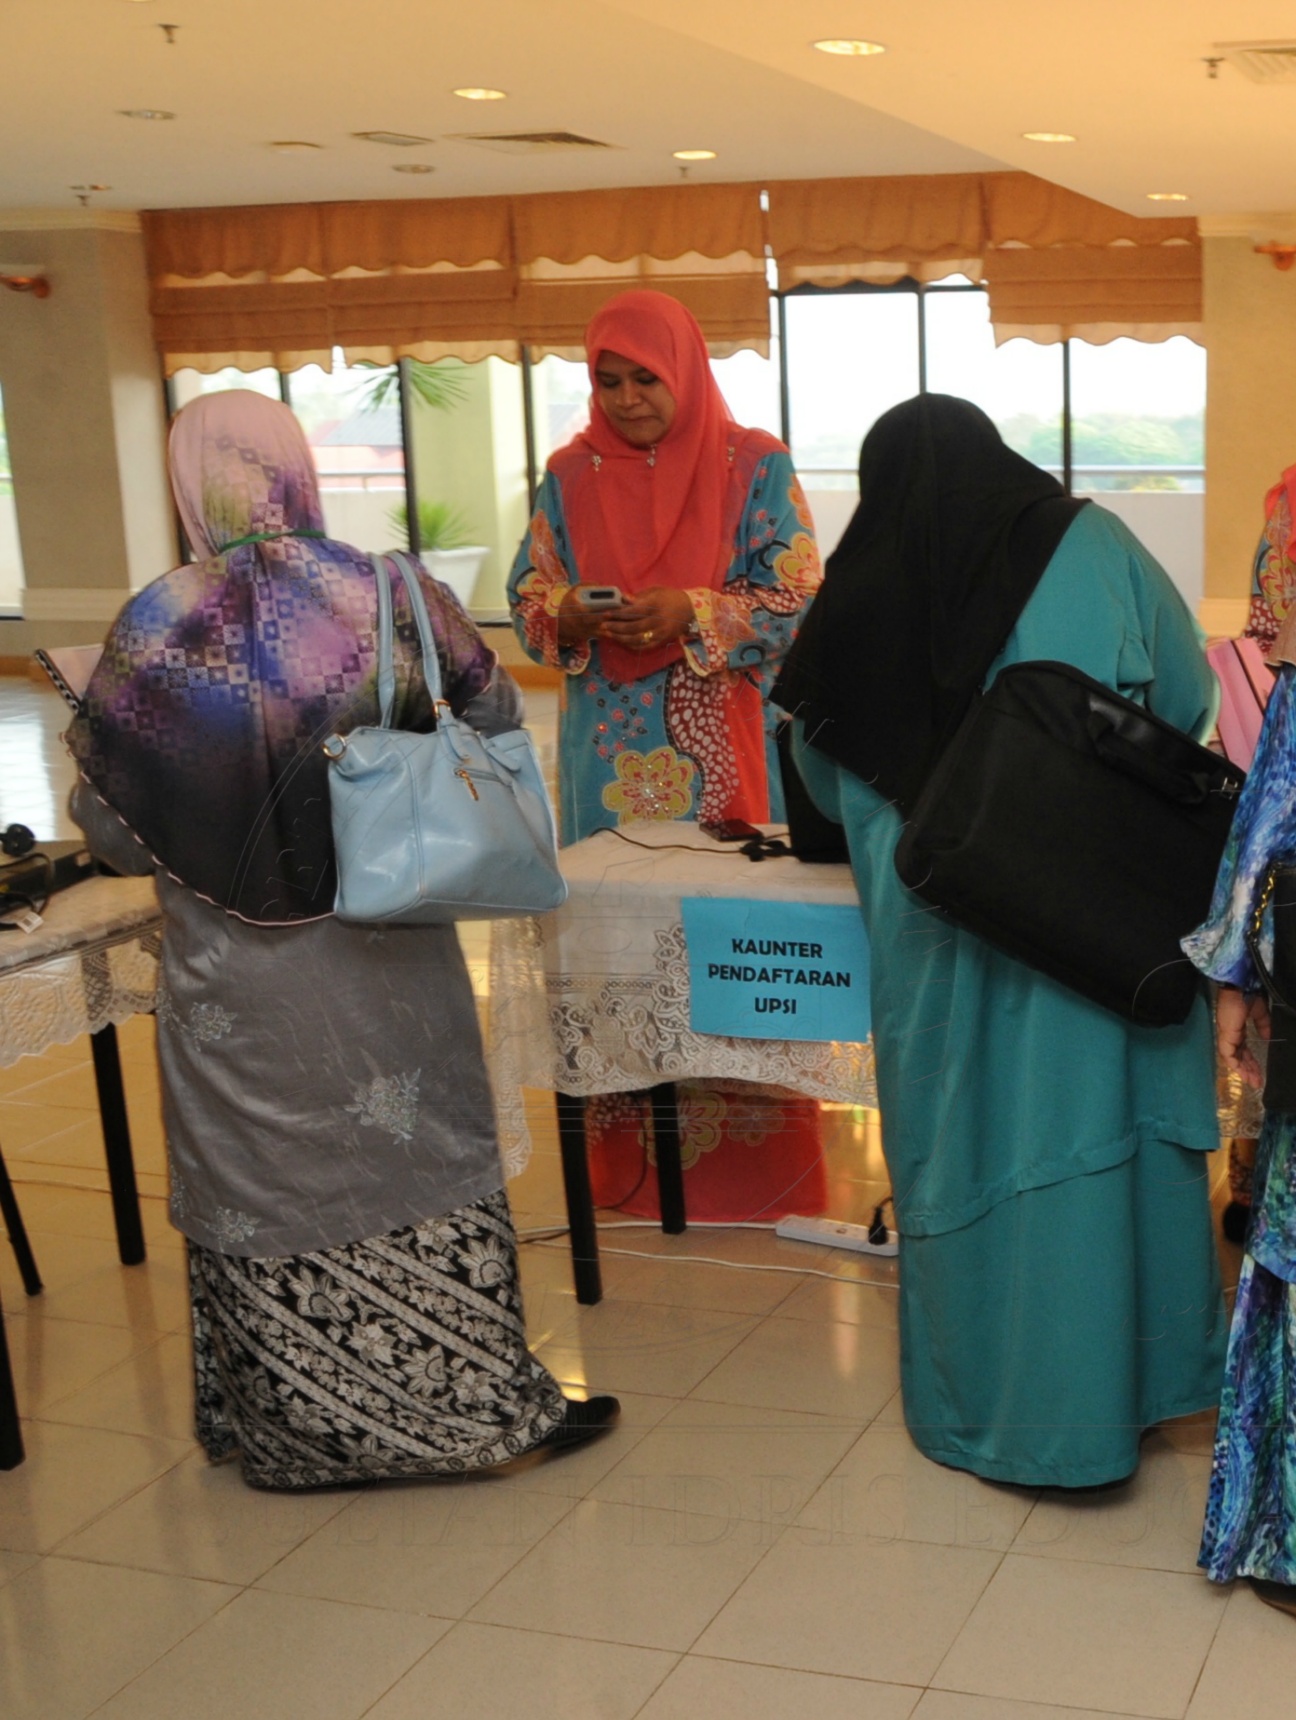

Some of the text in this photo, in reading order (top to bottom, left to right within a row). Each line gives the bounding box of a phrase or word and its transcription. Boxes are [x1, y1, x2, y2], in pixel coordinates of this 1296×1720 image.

[731, 938, 824, 959] KAUNTER
[707, 963, 851, 988] PENDAFTARAN
[754, 996, 797, 1015] UPSI
